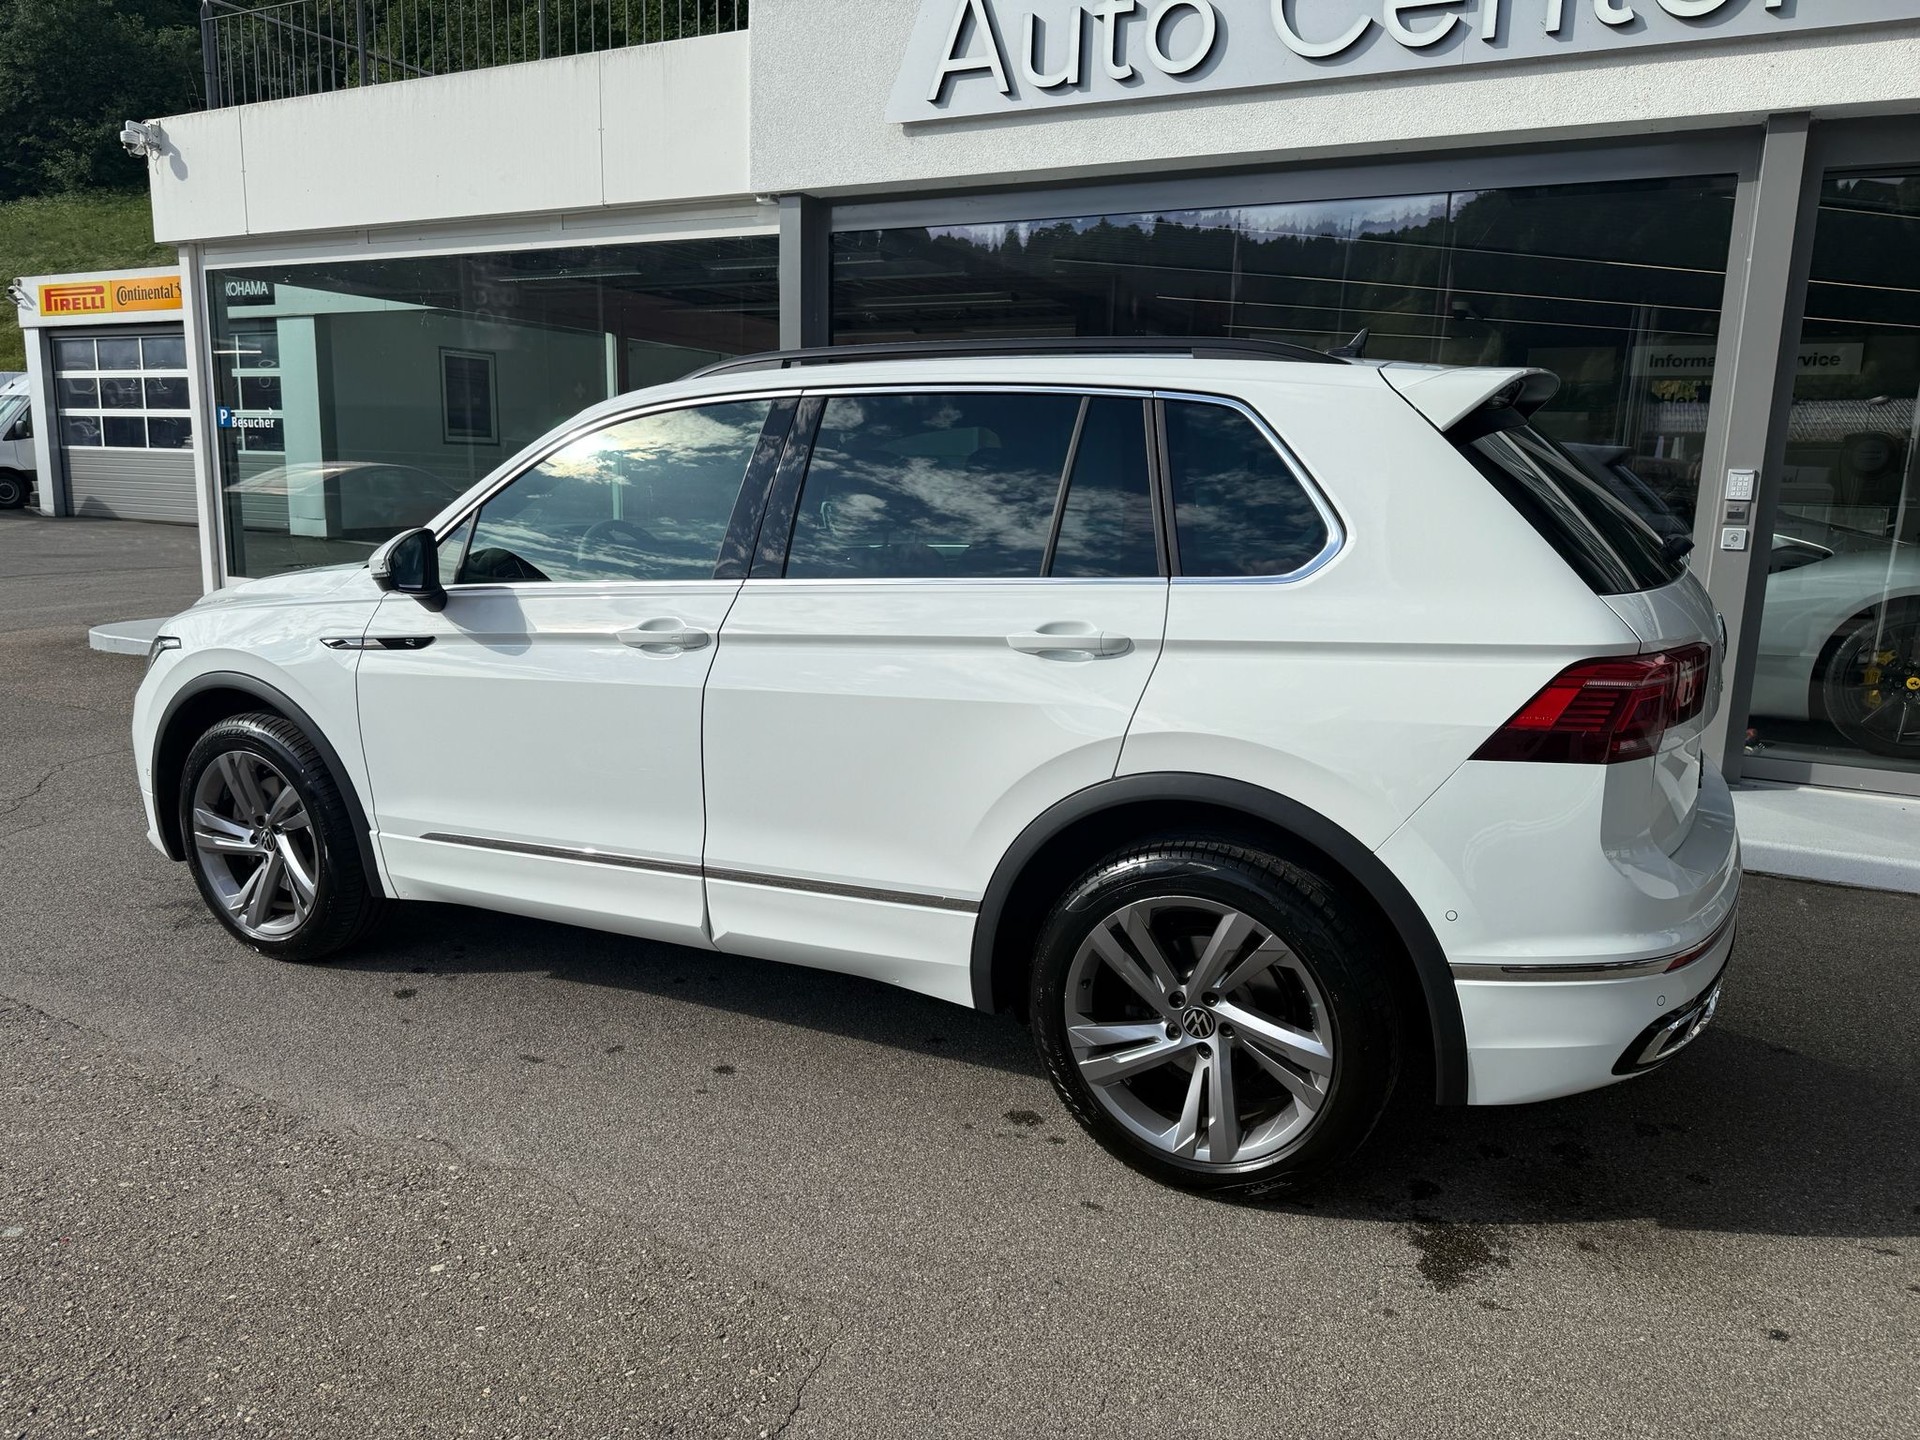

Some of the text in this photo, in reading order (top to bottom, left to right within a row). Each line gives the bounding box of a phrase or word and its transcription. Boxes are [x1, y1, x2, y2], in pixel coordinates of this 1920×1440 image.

[928, 0, 1216, 101] Auto
[44, 285, 106, 312] PIRELLI
[116, 283, 174, 307] Continental
[219, 408, 276, 429] P Besucher
